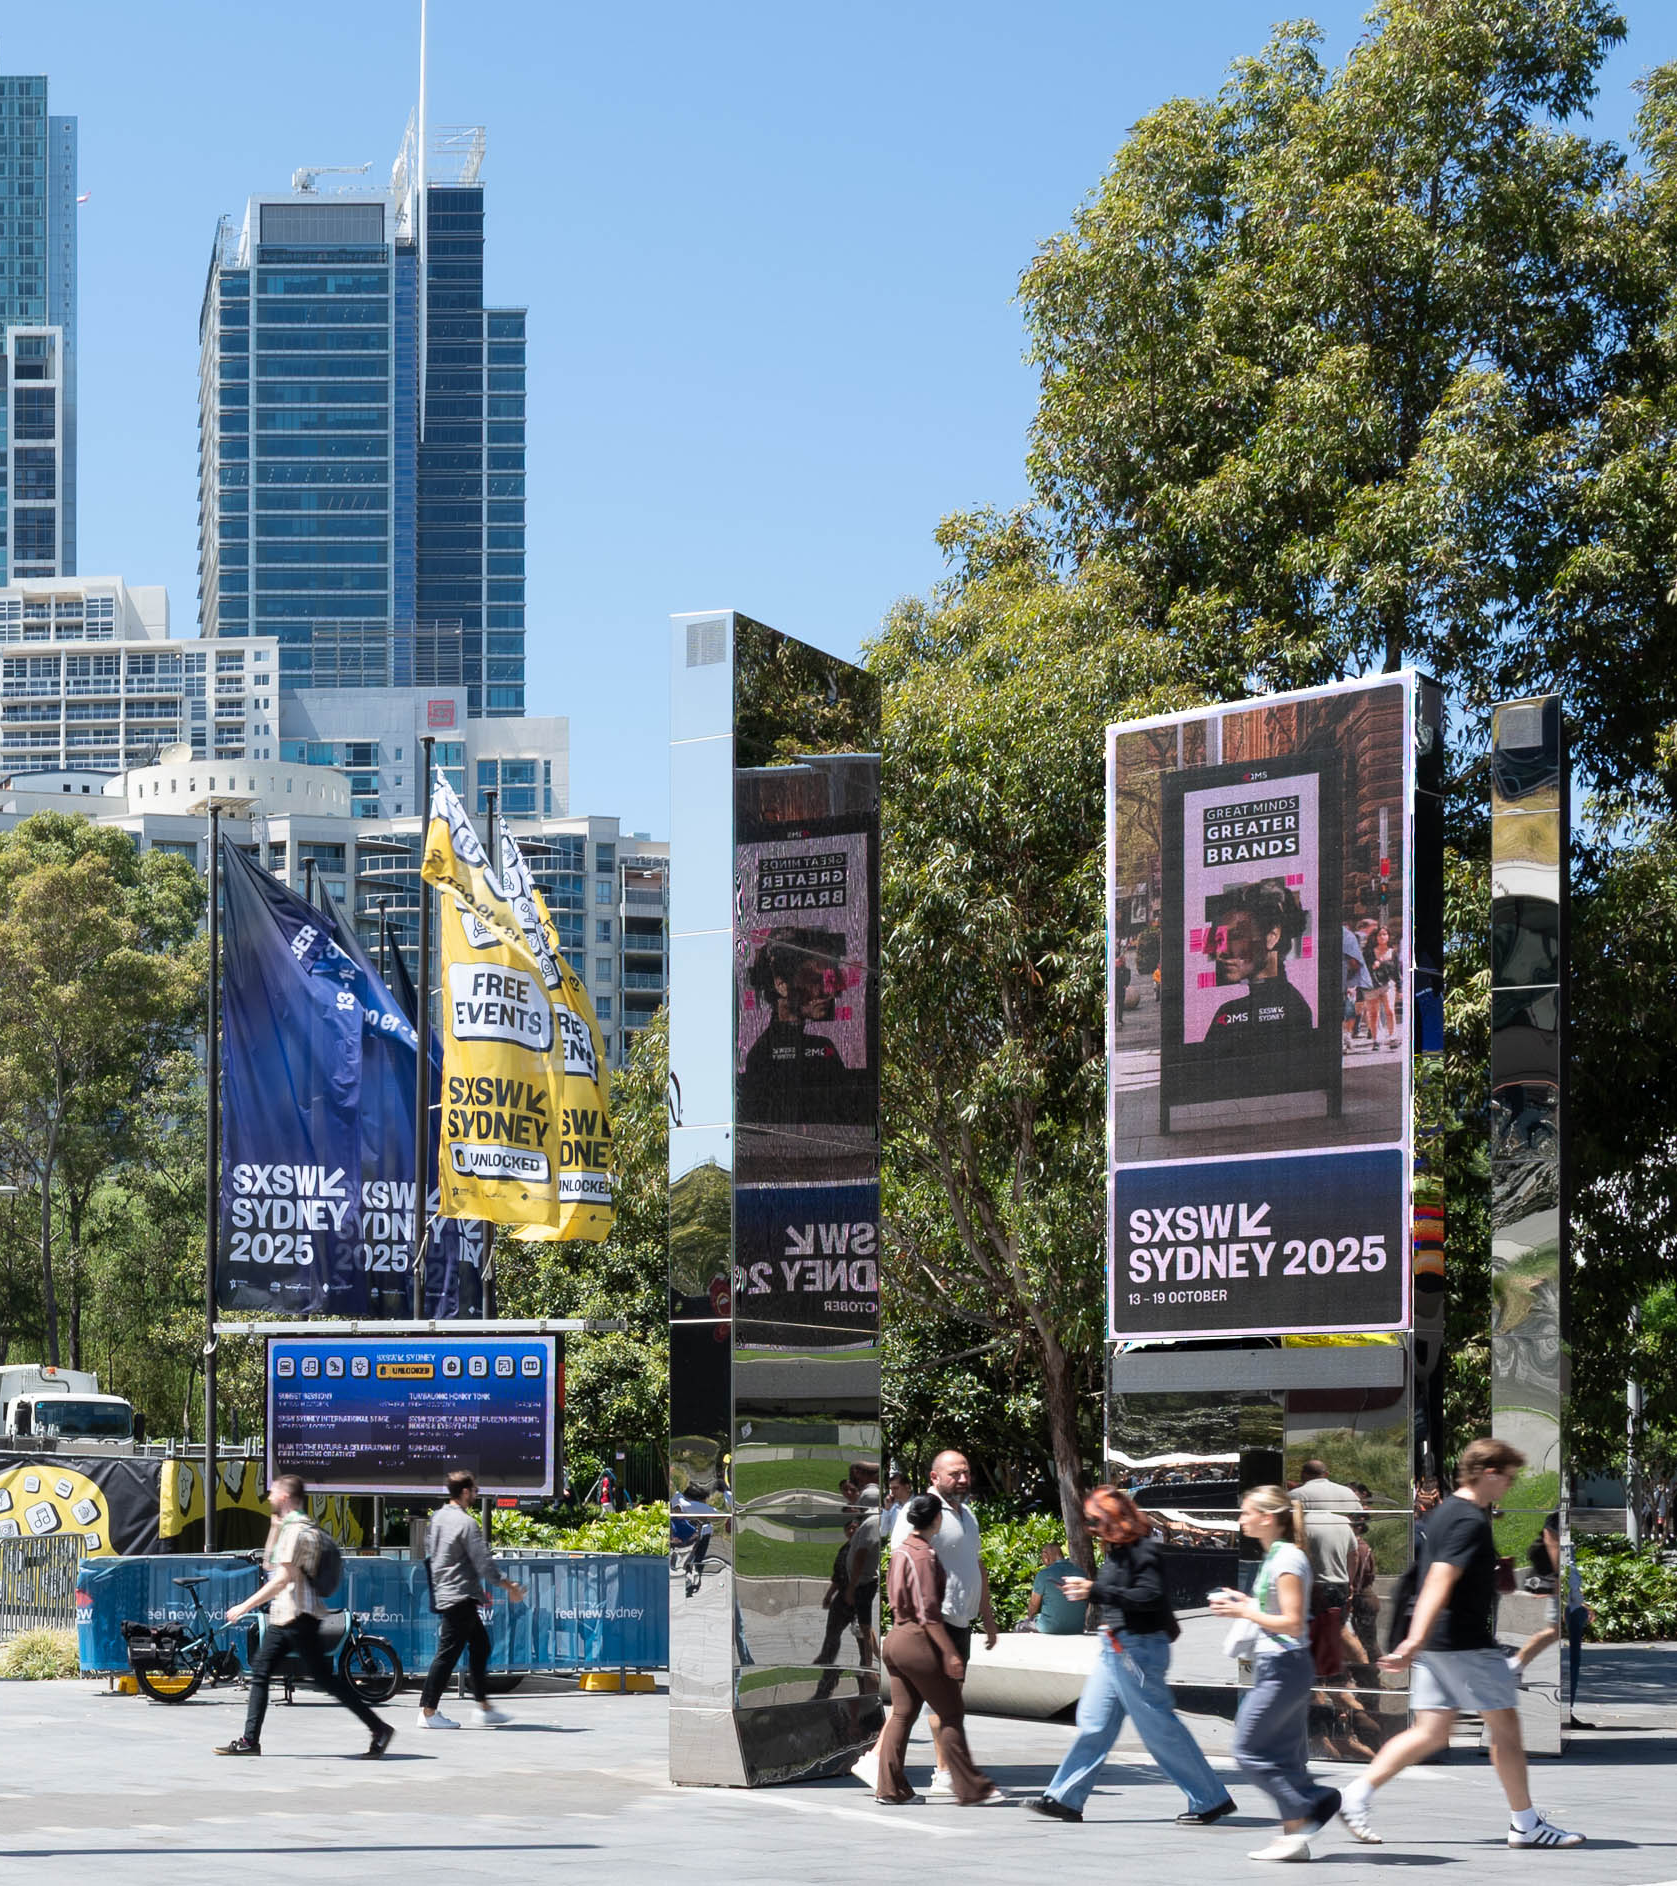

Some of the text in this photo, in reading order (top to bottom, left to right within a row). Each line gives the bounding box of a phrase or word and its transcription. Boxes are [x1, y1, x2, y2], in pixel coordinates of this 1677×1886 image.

[1207, 798, 1296, 820] GREAT MINDS
[1207, 815, 1296, 840] GREATER
[1207, 838, 1296, 864] BRANDS
[472, 973, 530, 1003] FREE
[456, 1002, 542, 1036] EVENTS
[449, 1077, 523, 1109] SXSW
[448, 1109, 550, 1147] SYDNEY
[562, 1109, 598, 1136] SW
[470, 1152, 540, 1172] UNLOCKED
[561, 1141, 608, 1168] DNE
[233, 1164, 317, 1197] SXSW
[232, 1198, 350, 1231] SYDNEY
[1129, 1204, 1234, 1244] SXSW
[229, 1232, 314, 1265] 2025
[1129, 1235, 1387, 1283] SYDNEY 2025
[1128, 1293, 1141, 1305] 13
[1152, 1292, 1165, 1304] 19
[1168, 1289, 1228, 1303] OCTOBER
[76, 1608, 93, 1620] SW
[148, 1609, 165, 1620] eel
[168, 1609, 197, 1620] new
[477, 1609, 494, 1622] SW
[555, 1606, 643, 1621] feel new sydney
